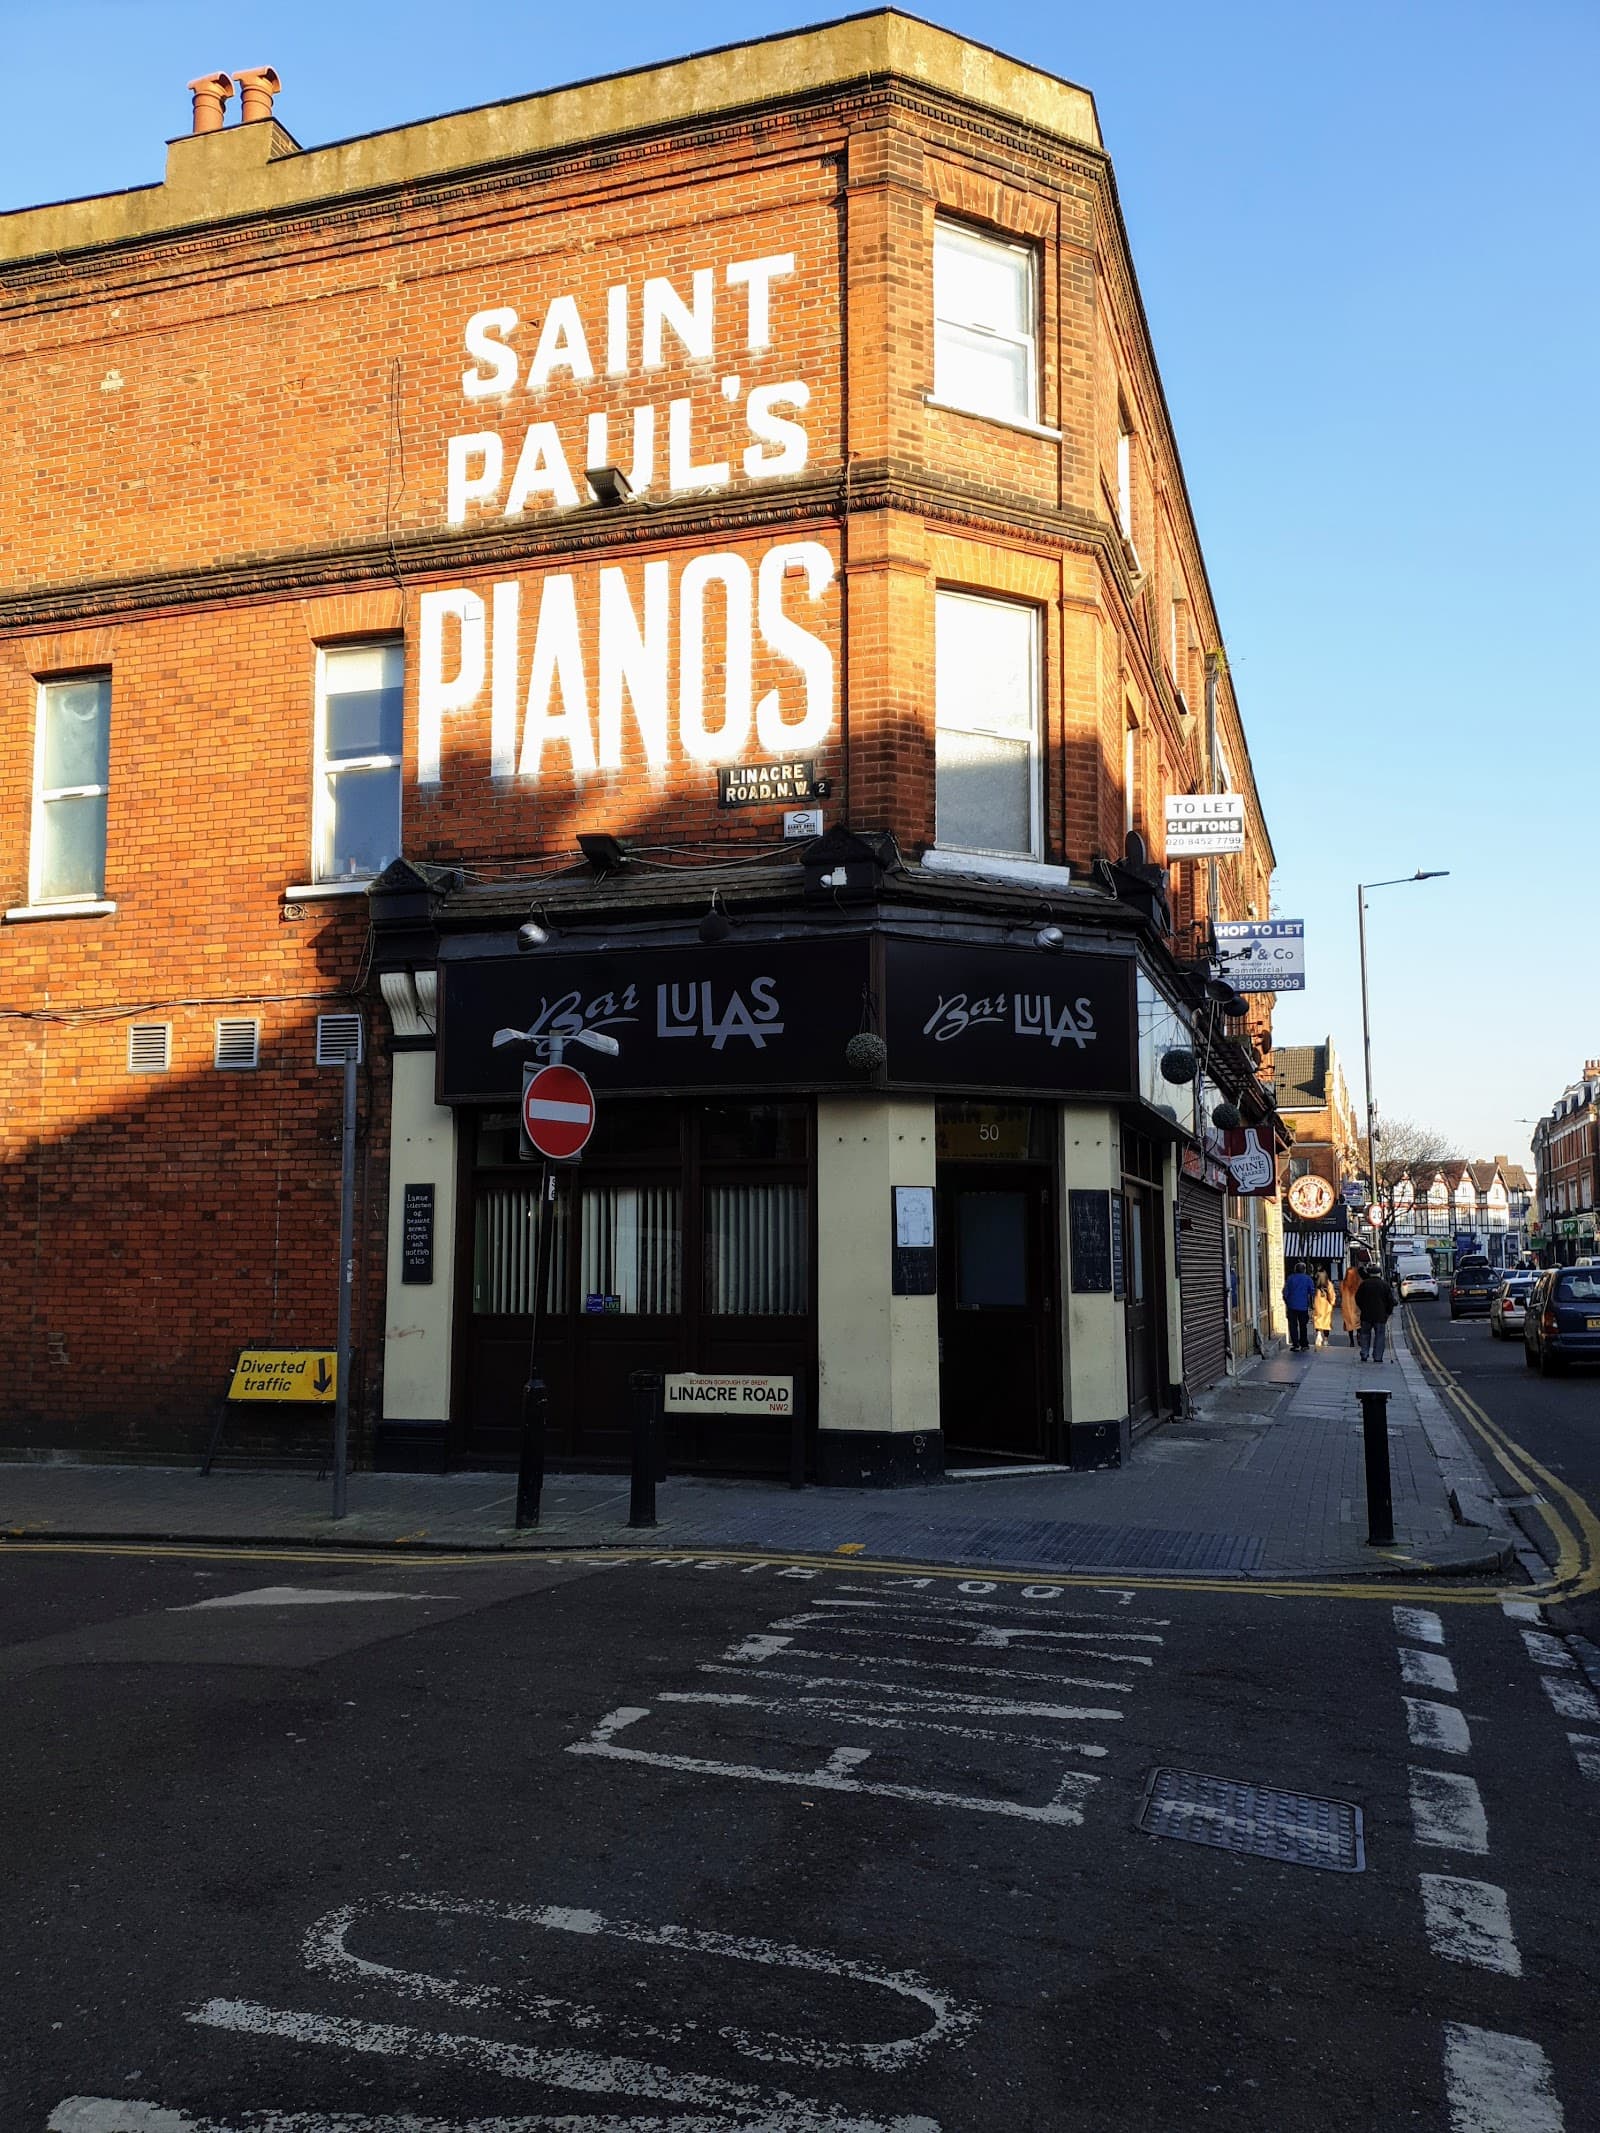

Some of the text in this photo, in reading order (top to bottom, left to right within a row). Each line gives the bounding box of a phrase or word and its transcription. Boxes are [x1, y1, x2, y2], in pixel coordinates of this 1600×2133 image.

[462, 253, 796, 400] SAINT
[447, 376, 810, 526] PAUL'S
[417, 540, 837, 788] PIANOS
[729, 764, 804, 785] LINACRE
[818, 782, 826, 793] 2
[1173, 802, 1235, 814] TO LET
[1167, 820, 1240, 833] CLIFTONS
[1166, 836, 1241, 846] 020 8452 7799
[1252, 925, 1272, 936] TO
[1276, 924, 1303, 935] LET
[1257, 948, 1268, 960] &
[1273, 948, 1294, 960] Co
[1238, 979, 1267, 989] 8903
[1270, 979, 1300, 989] 3909
[527, 976, 785, 1058] Bar LULAS
[922, 992, 1097, 1050] Bar LULAS
[979, 1122, 1000, 1141] 50
[1234, 1160, 1265, 1173] WINE
[1372, 1210, 1382, 1219] 20
[240, 1359, 306, 1373] Diverted
[244, 1378, 292, 1392] traffic
[669, 1386, 789, 1402] LINACRE ROAD
[769, 1403, 789, 1412] NW2
